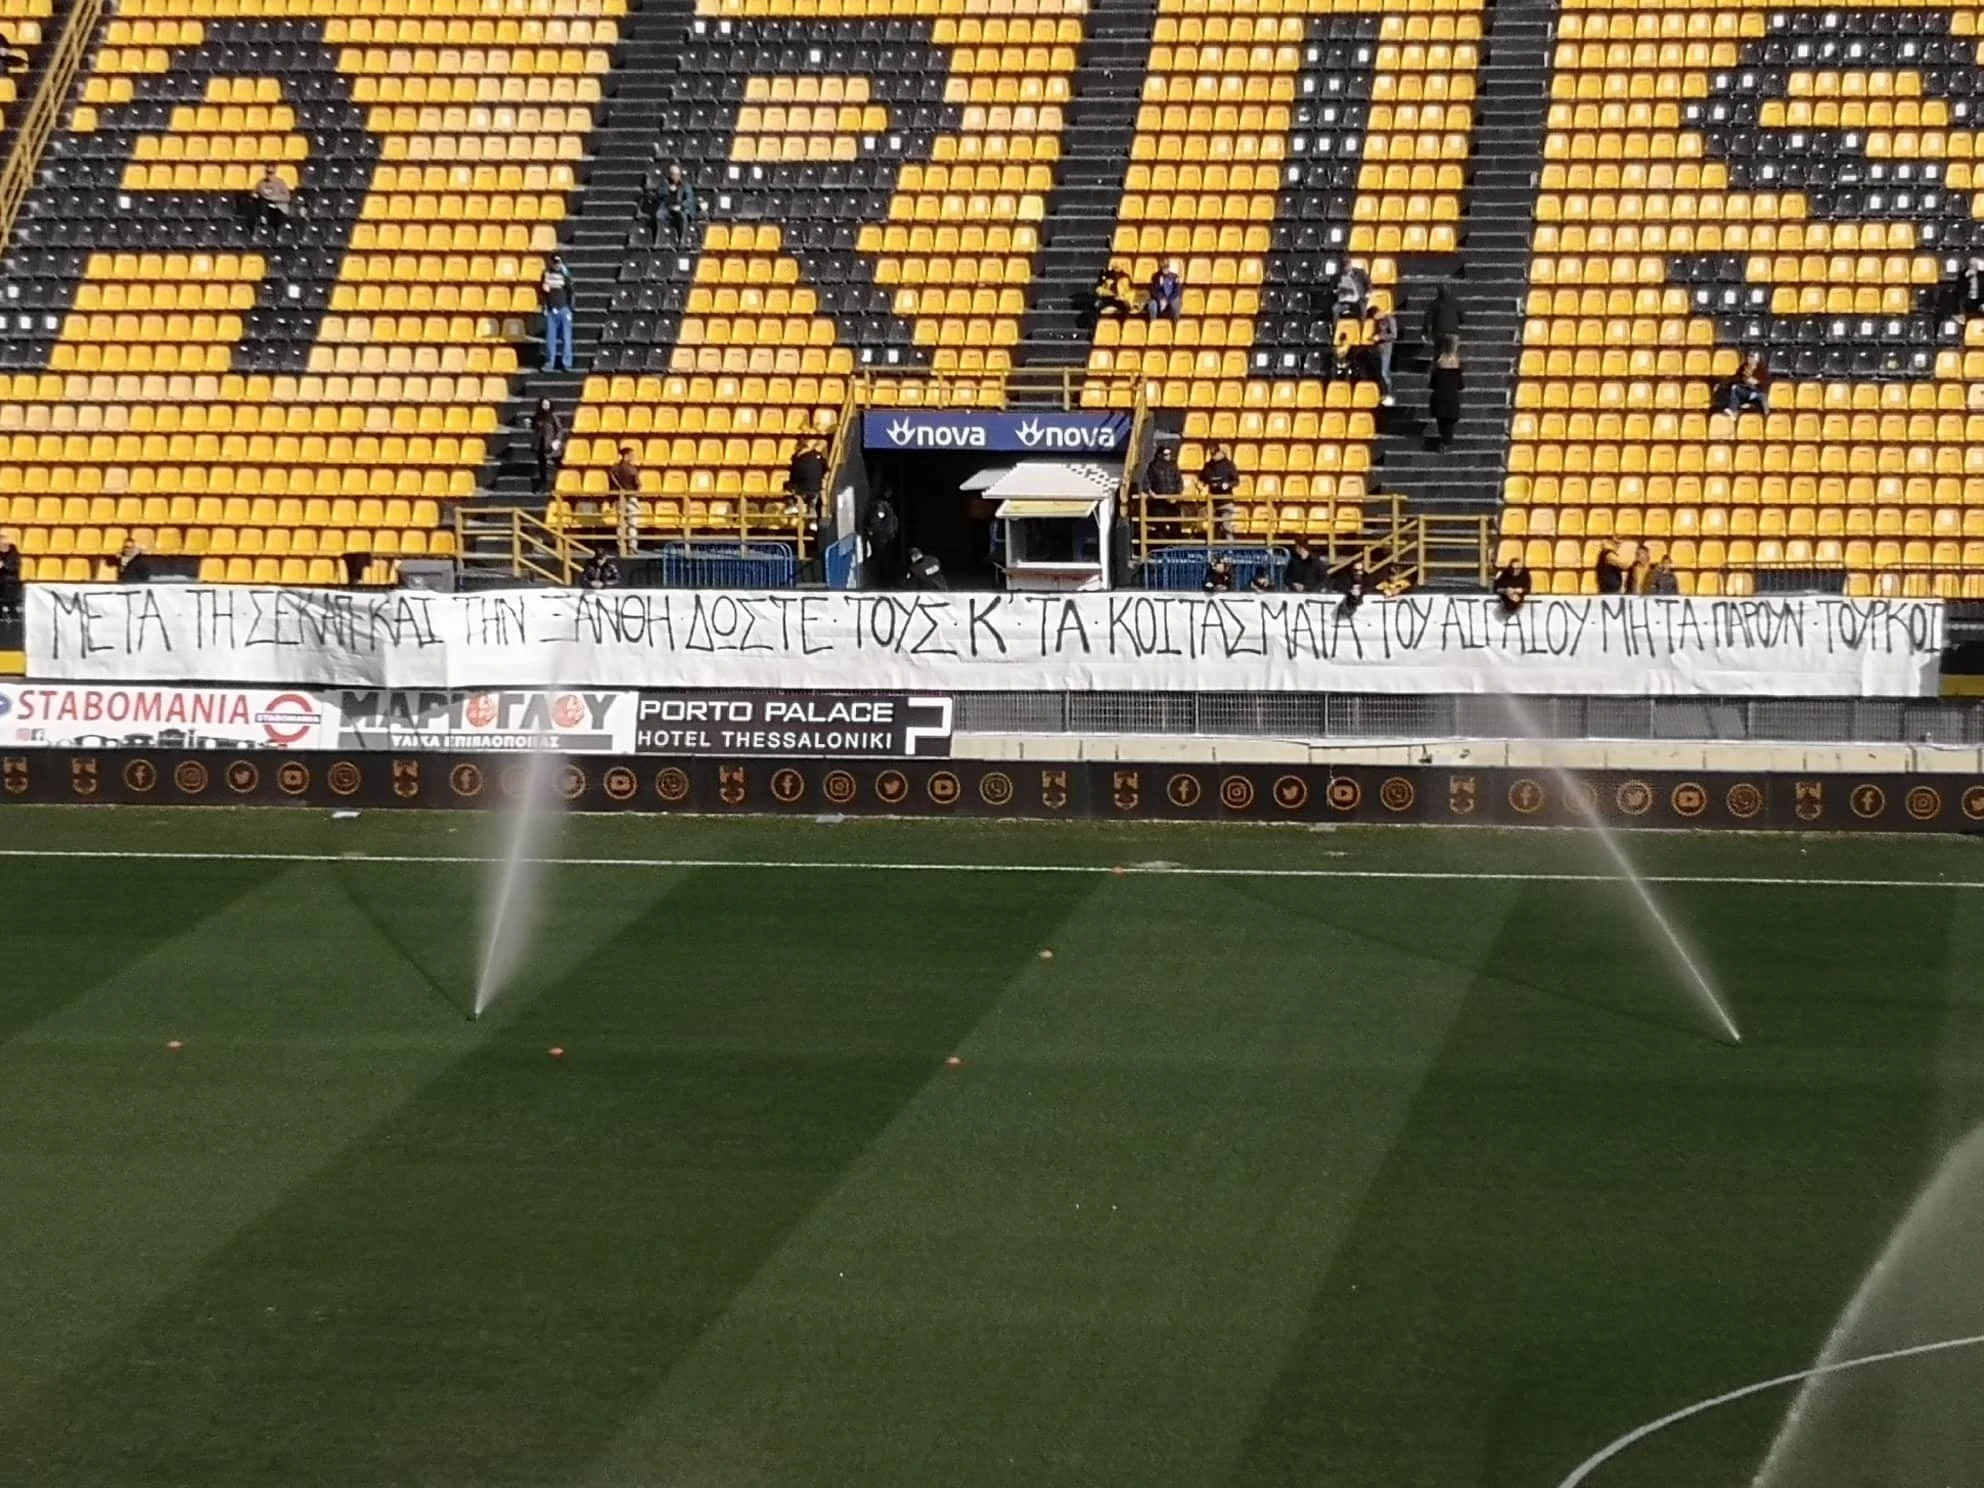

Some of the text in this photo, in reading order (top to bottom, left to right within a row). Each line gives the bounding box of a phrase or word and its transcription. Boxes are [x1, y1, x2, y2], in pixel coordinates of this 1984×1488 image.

[917, 425, 1115, 448] nova nova
[45, 590, 171, 660] ΜΕΤΑ
[186, 590, 234, 650] ΤΗ
[367, 595, 445, 651] ΚΑΙ
[453, 595, 526, 646] ΤΗΝ
[539, 594, 674, 651] ΞΑΝΘΗ
[845, 596, 959, 656] ΤΟΥΣ
[1026, 596, 1091, 657] ΤΑ
[1372, 597, 1433, 660] ΤΟΥ
[1601, 598, 1656, 659] ΜΗ
[1656, 598, 1705, 655] ΤΑ
[1817, 598, 1945, 656] ΤΟΥΡΚΟΙ
[17, 689, 250, 725] STABOMANIA
[639, 699, 894, 723] PORTO PALACE
[637, 729, 892, 749] HOTEL THESSALONIKI
